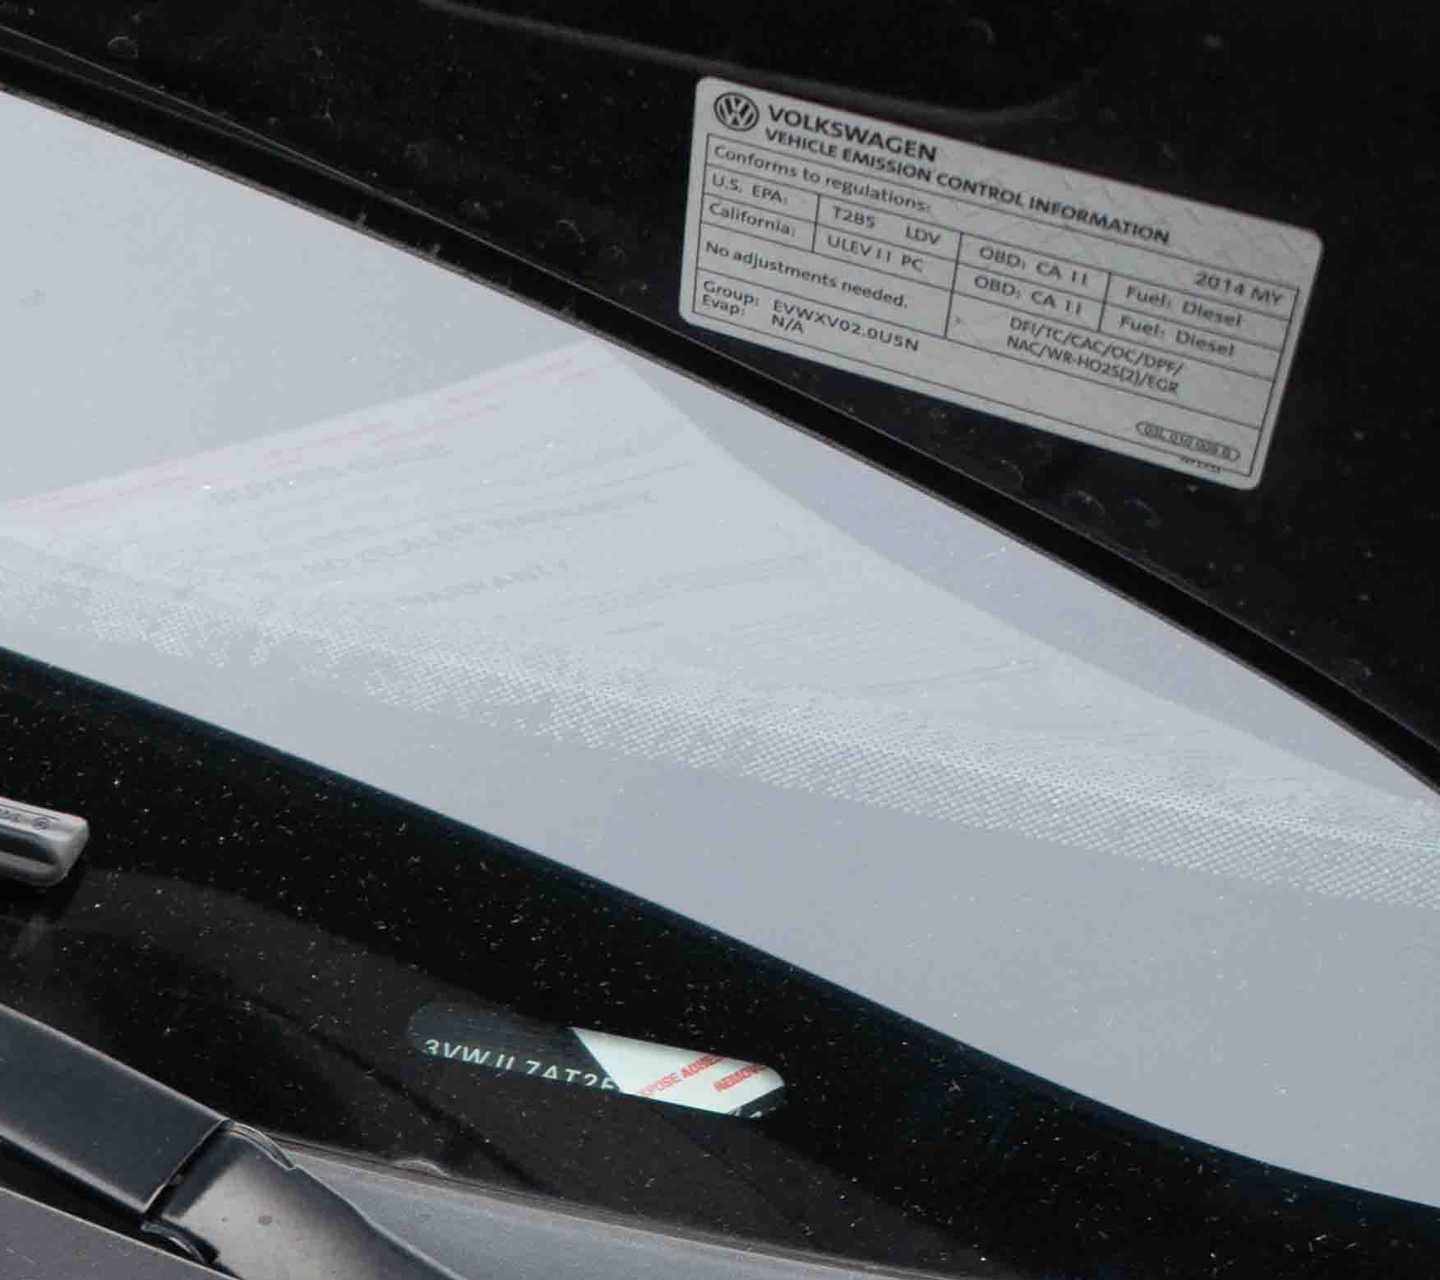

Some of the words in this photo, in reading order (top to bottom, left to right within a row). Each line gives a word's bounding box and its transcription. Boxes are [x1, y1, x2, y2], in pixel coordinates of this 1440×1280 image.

[768, 104, 937, 162] VOLKSWAGEN
[714, 145, 796, 177] Conforms
[803, 167, 820, 183] to
[826, 176, 930, 213] regulations:
[751, 184, 787, 205] EPA:
[765, 127, 837, 157] VEHICLE
[843, 150, 931, 182] EMISSION
[936, 172, 1023, 209] CONTROL
[1030, 196, 1169, 244] INFORMATION
[708, 202, 795, 237] California:
[905, 226, 941, 246] LDV
[705, 240, 729, 258] No
[733, 249, 836, 289] adjustments
[841, 278, 908, 308] needed.
[901, 252, 924, 272] PC
[979, 246, 1026, 270] OBD:
[1036, 261, 1062, 281] CA
[703, 279, 759, 306] Group:
[974, 275, 1022, 299] OBD:
[1031, 289, 1057, 310] CA
[1193, 270, 1245, 298] 2014
[1251, 285, 1285, 306] MY
[701, 294, 746, 317] Evap:
[771, 315, 805, 335] N/A
[1126, 285, 1172, 309] Fuel:
[1182, 300, 1243, 328] Diesel
[1119, 313, 1166, 338] Fuel:
[1175, 328, 1236, 356] Diesel
